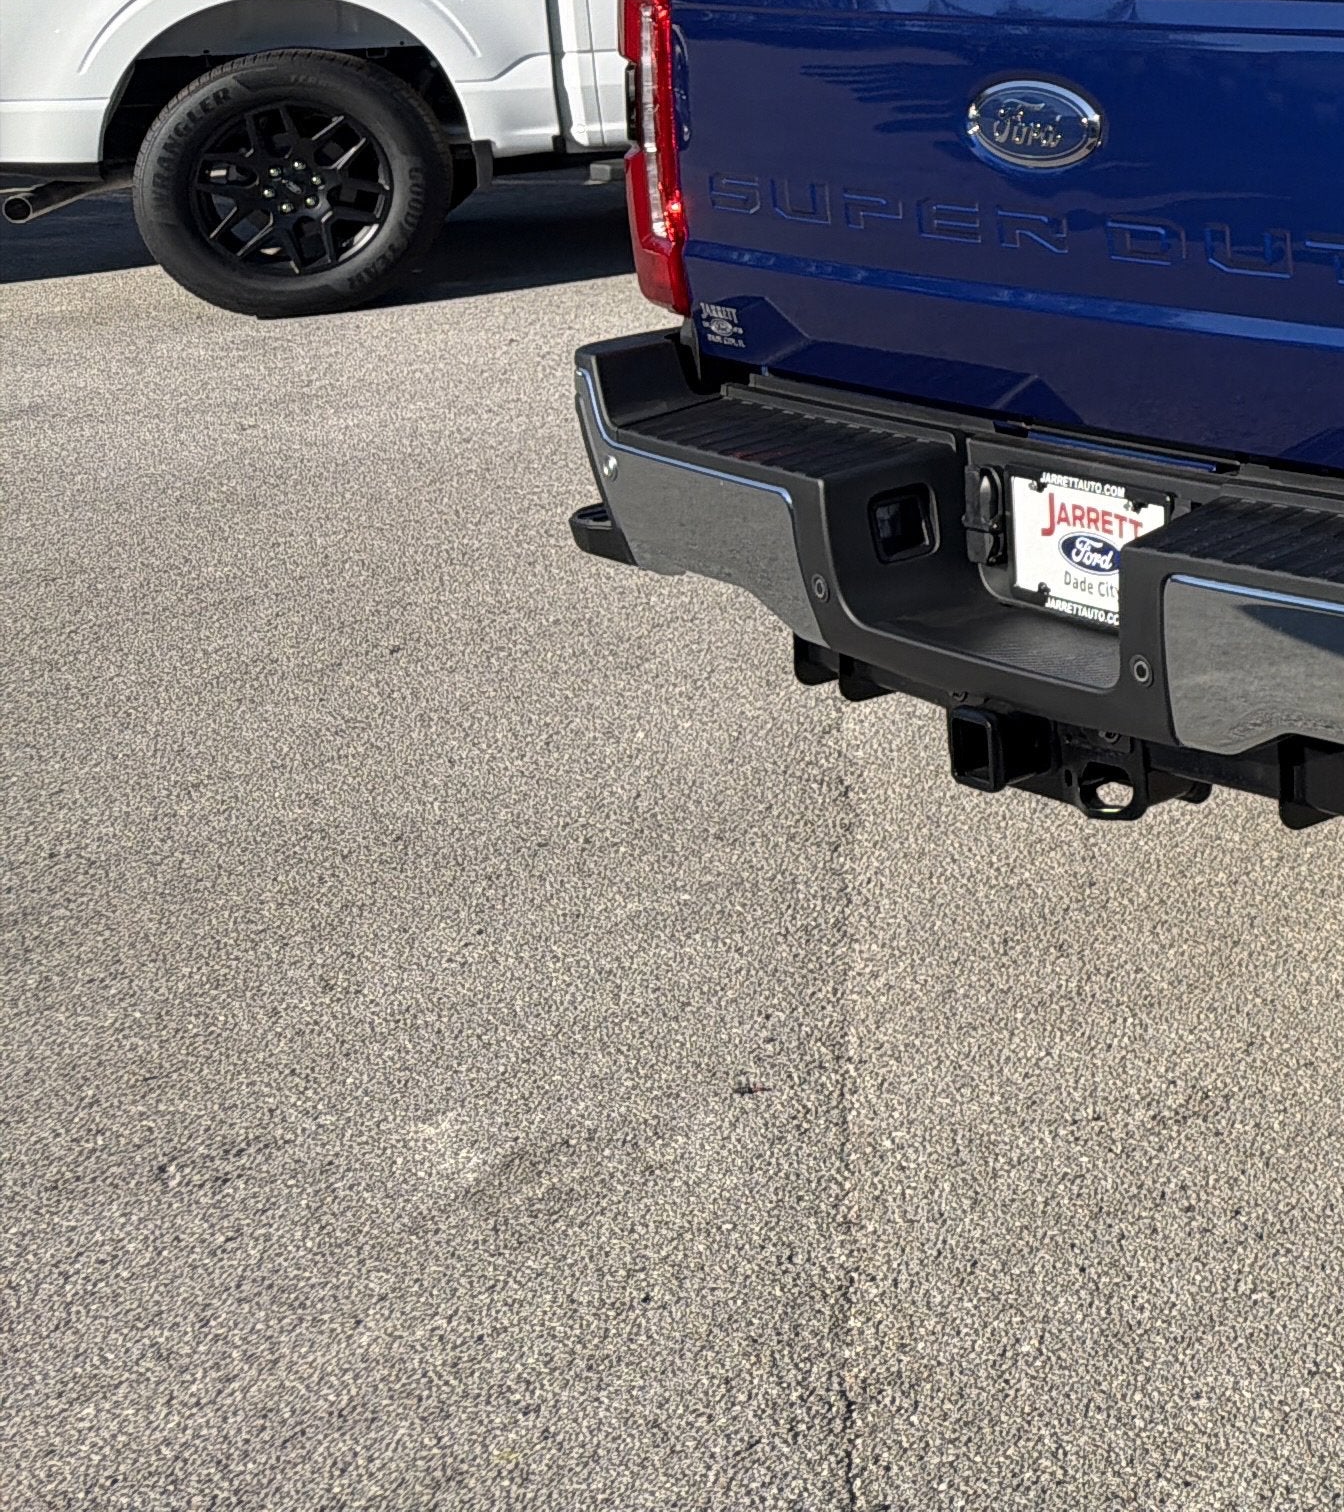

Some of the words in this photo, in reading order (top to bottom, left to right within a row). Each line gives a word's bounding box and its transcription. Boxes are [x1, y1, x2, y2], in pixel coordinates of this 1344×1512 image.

[993, 98, 1063, 148] Ford
[708, 172, 1069, 253] SUPER
[1040, 471, 1125, 498] JARRETTAUTO.COM
[1041, 492, 1143, 539] JARRETT
[1071, 537, 1112, 570] Ford
[1064, 571, 1094, 596] Dade
